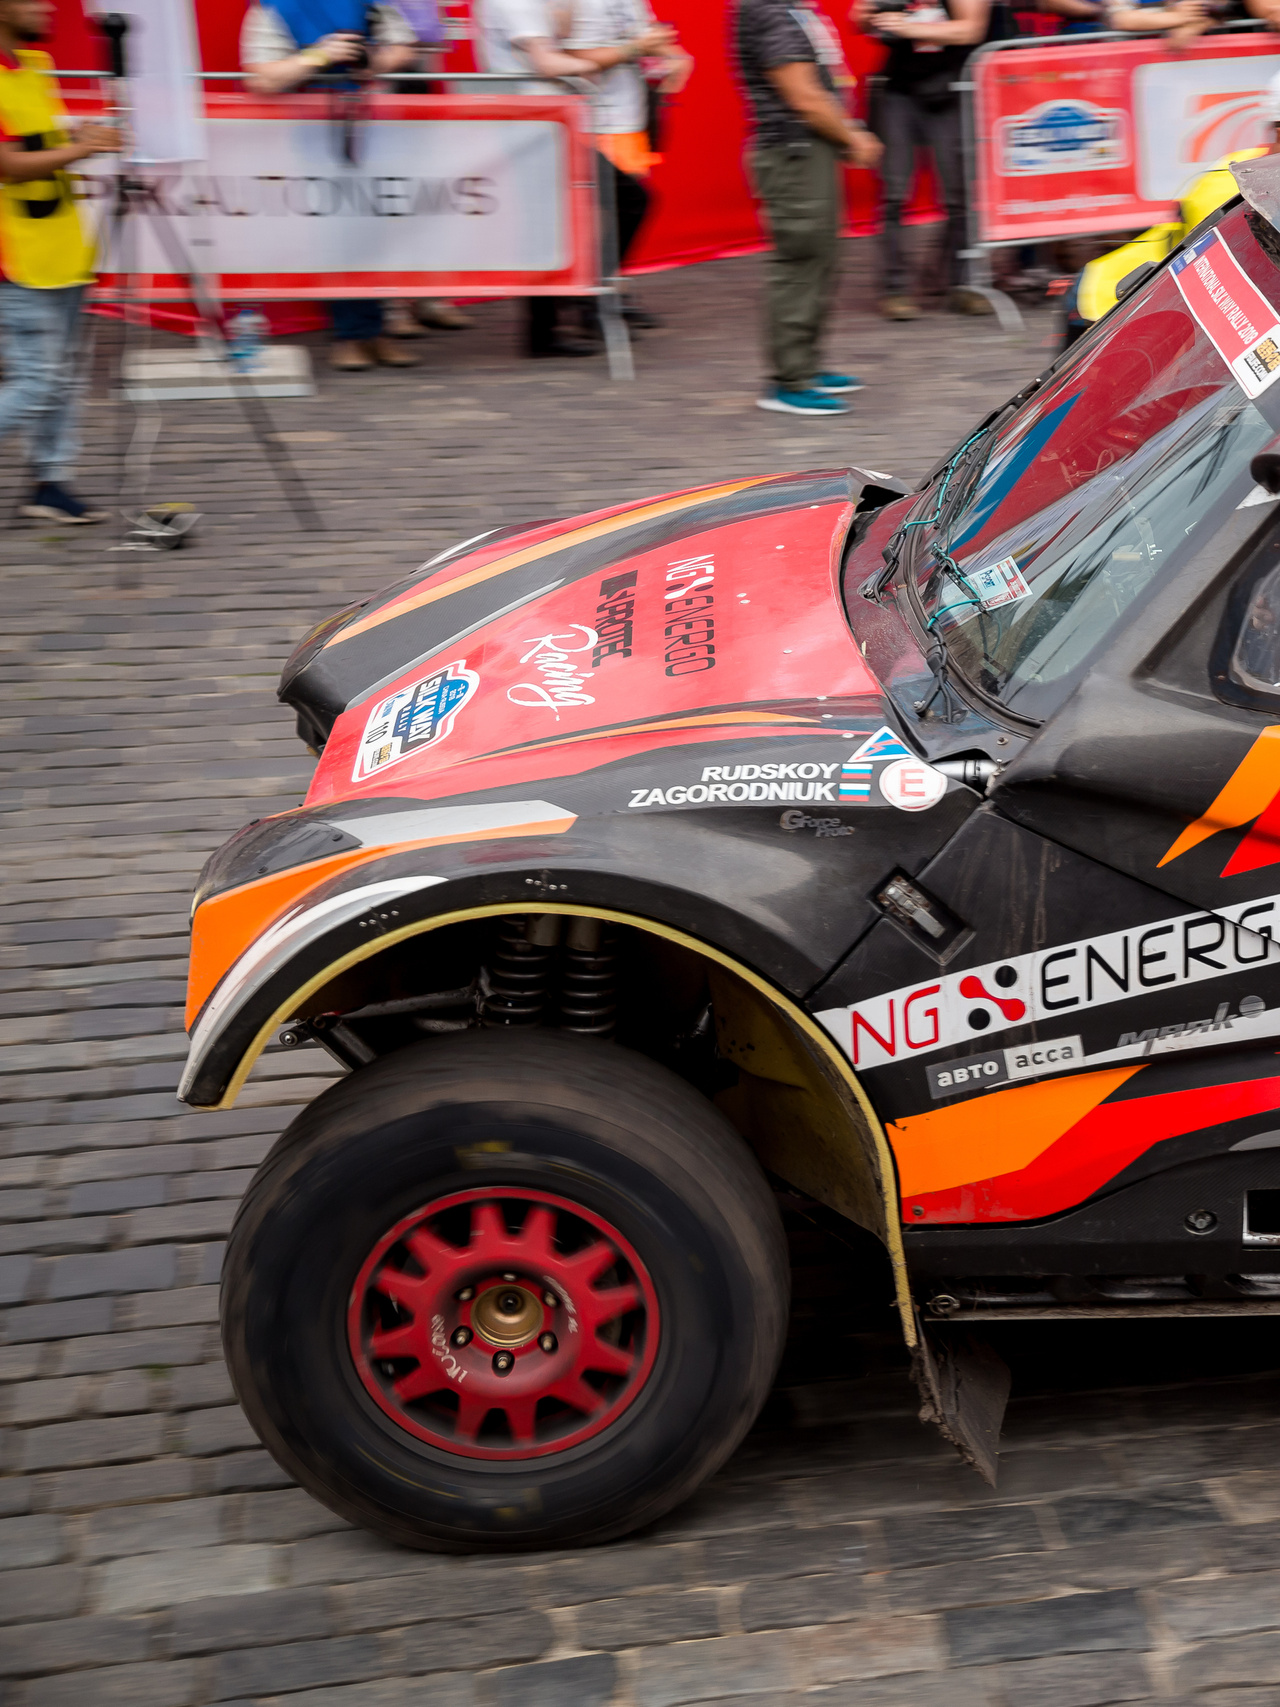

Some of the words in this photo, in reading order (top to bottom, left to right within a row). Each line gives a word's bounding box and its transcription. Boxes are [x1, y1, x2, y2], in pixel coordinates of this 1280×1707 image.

[1193, 255, 1222, 299] INTERNATIONAL
[1211, 285, 1229, 306] SILK
[1218, 296, 1237, 315] WAY
[1226, 304, 1249, 331] RALLY
[1238, 323, 1259, 345] 2018
[664, 595, 715, 677] ENERGO
[507, 624, 598, 721] Racing
[413, 676, 442, 714] SILK
[398, 705, 412, 732] RALLY
[407, 706, 436, 742] WAY
[365, 721, 389, 744] 110
[701, 763, 841, 781] RUDSKOY
[899, 768, 926, 797] E
[628, 782, 836, 808] ZAGORODNIUK
[849, 984, 941, 1065] NG
